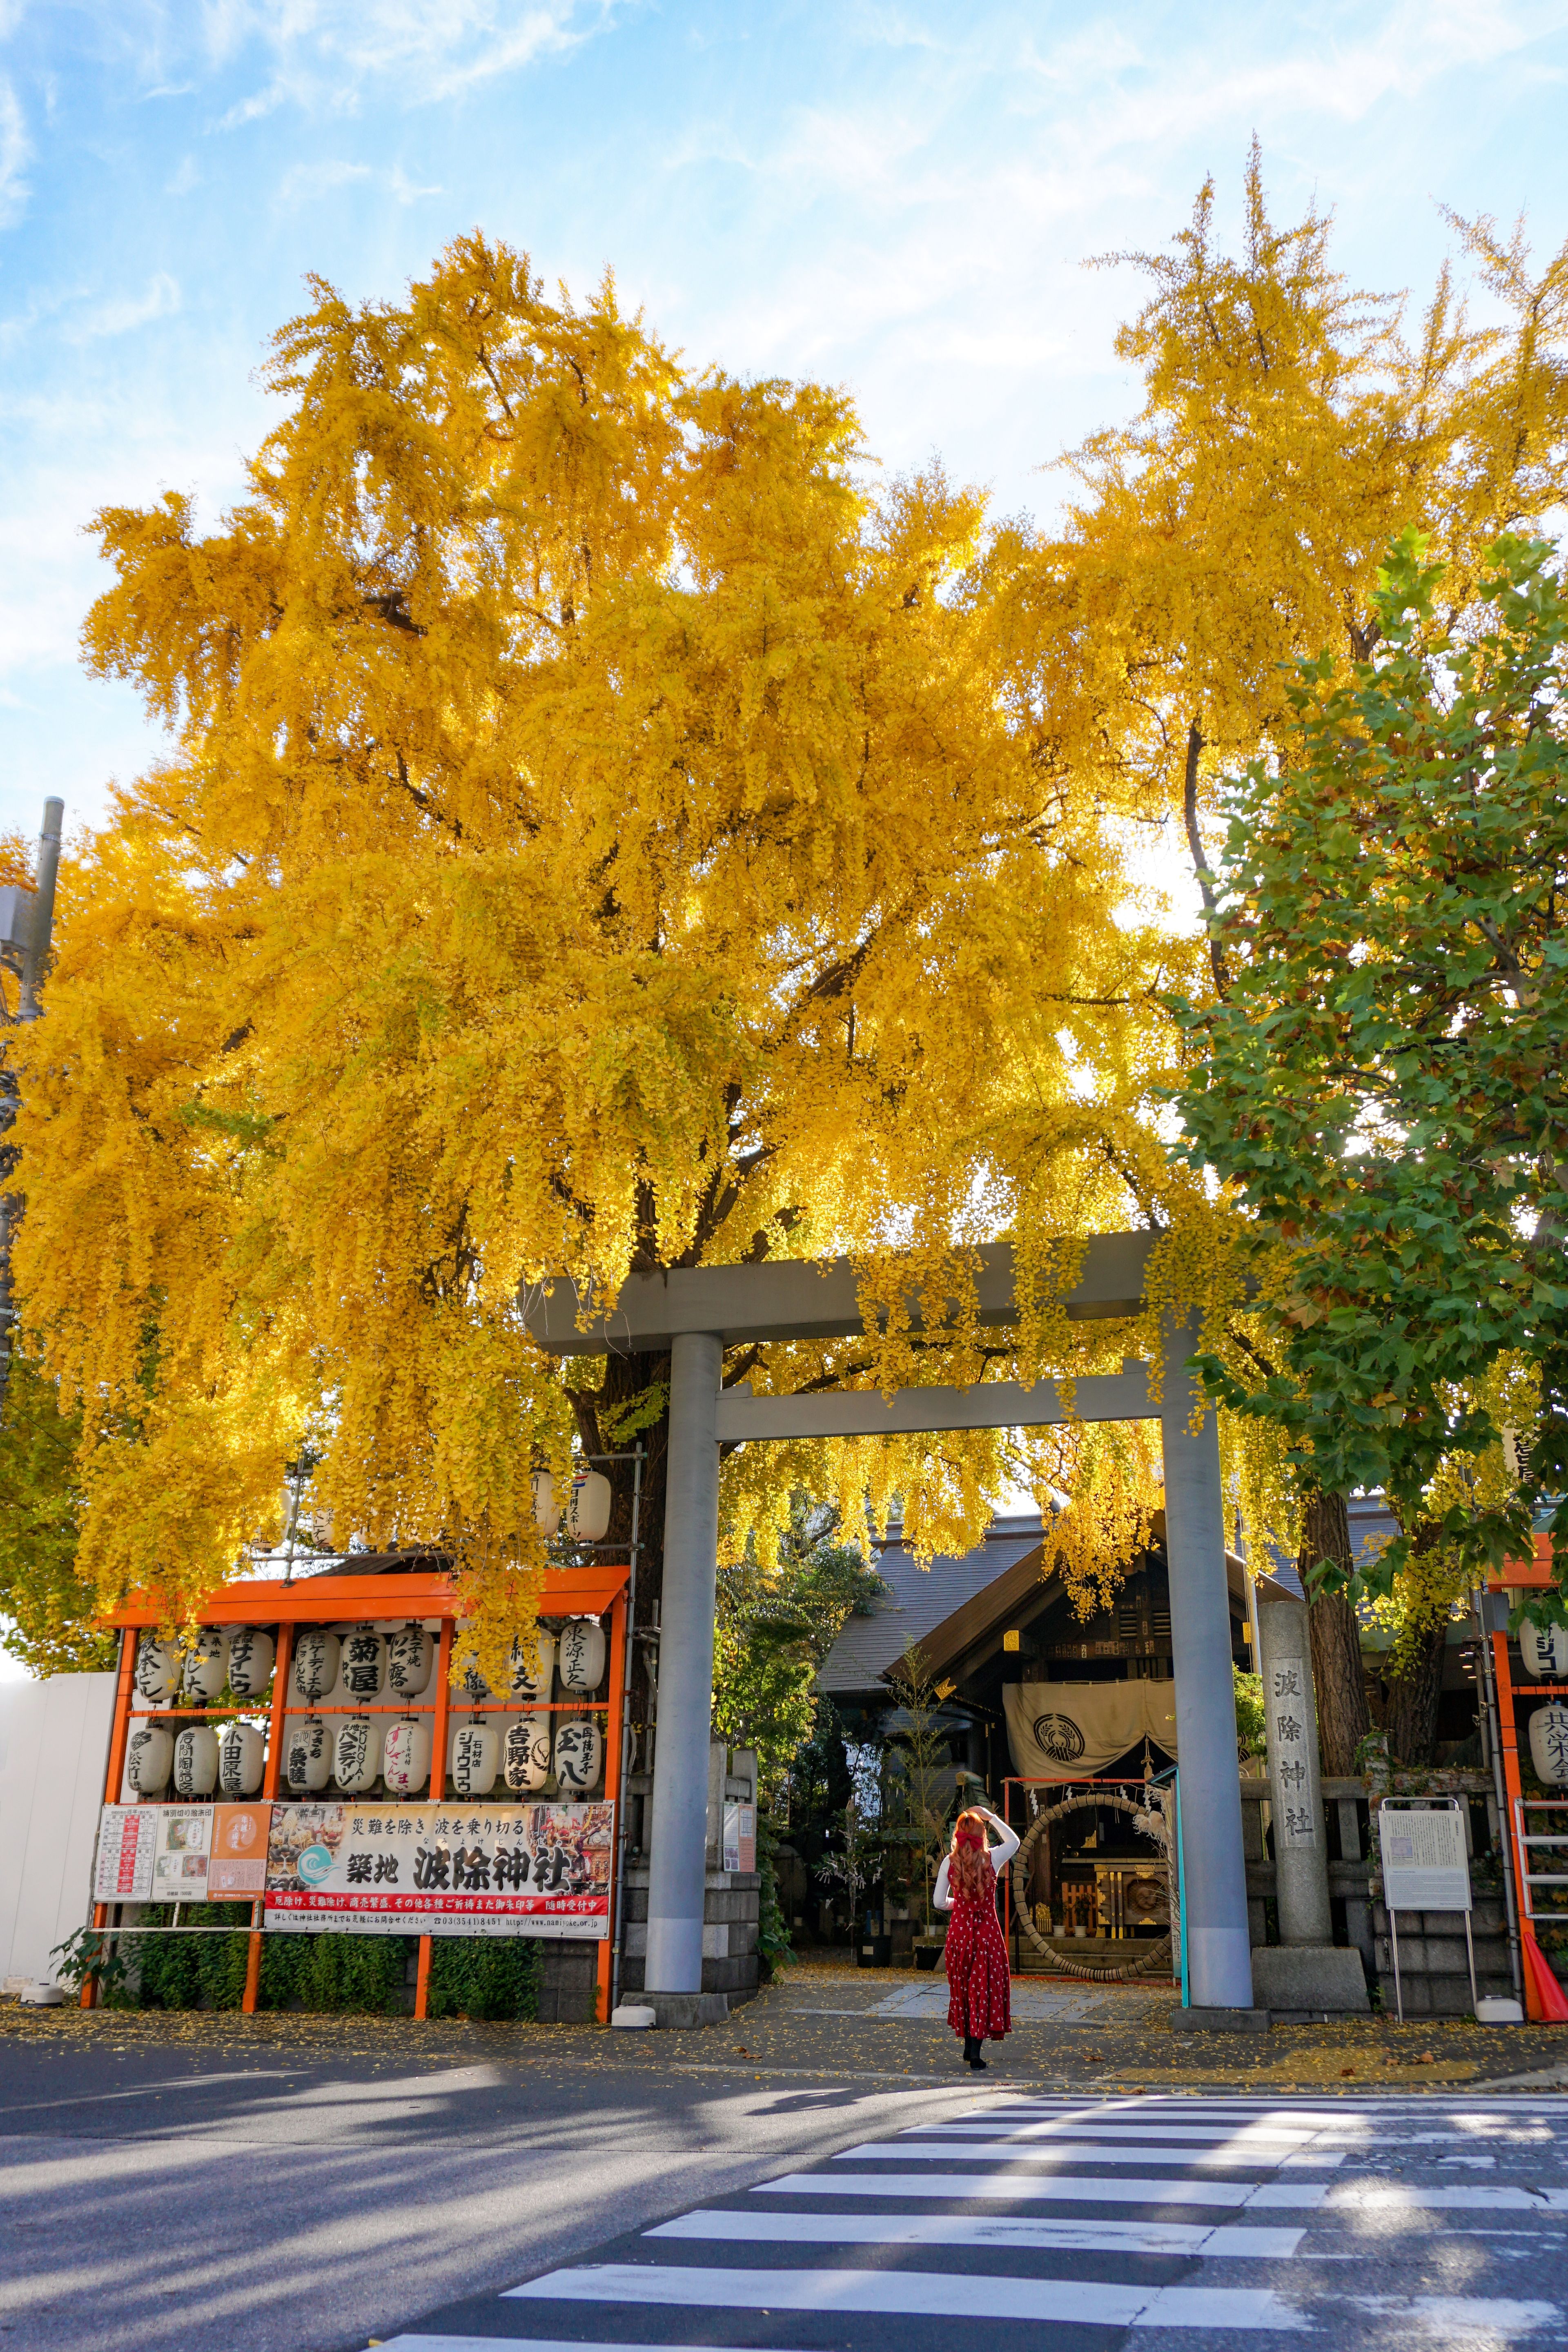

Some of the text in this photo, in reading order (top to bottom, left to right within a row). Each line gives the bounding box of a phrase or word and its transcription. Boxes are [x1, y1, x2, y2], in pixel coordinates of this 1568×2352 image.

[570, 1488, 581, 1538] 日刊スポーツ
[139, 1636, 163, 1698] 秋本ビル
[230, 1644, 254, 1694] サイトウ
[307, 1644, 325, 1694] ケーディーエム
[349, 1636, 380, 1693] 菊屋
[406, 1630, 424, 1667] 玉子焼
[564, 1625, 587, 1687] 東源正久
[1536, 1626, 1557, 1671] ジコ
[128, 1751, 142, 1780] 松竹
[178, 1732, 196, 1792] 岩間陶器店
[222, 1731, 244, 1792] 小田原屋
[309, 1728, 324, 1759] つきぢ
[338, 1731, 358, 1786] パラディーゾ
[385, 1726, 409, 1791] すしざんまい
[457, 1731, 474, 1792] ジョウコウ
[471, 1740, 483, 1768] 石材店
[508, 1725, 531, 1787] 吉野家
[557, 1727, 587, 1787] 玉八
[579, 1727, 595, 1775] 厚焼玉子
[1274, 1670, 1314, 1837] 波除神社
[351, 1817, 524, 1836] 災難を除き 波を乗り切る
[346, 1845, 570, 1893] 築地 波除神社
[442, 1916, 501, 1926] 03(3541)8451
[506, 1917, 598, 1927] http://www.namiyoke.or.jp
[545, 1899, 597, 1911] 随時受付中
